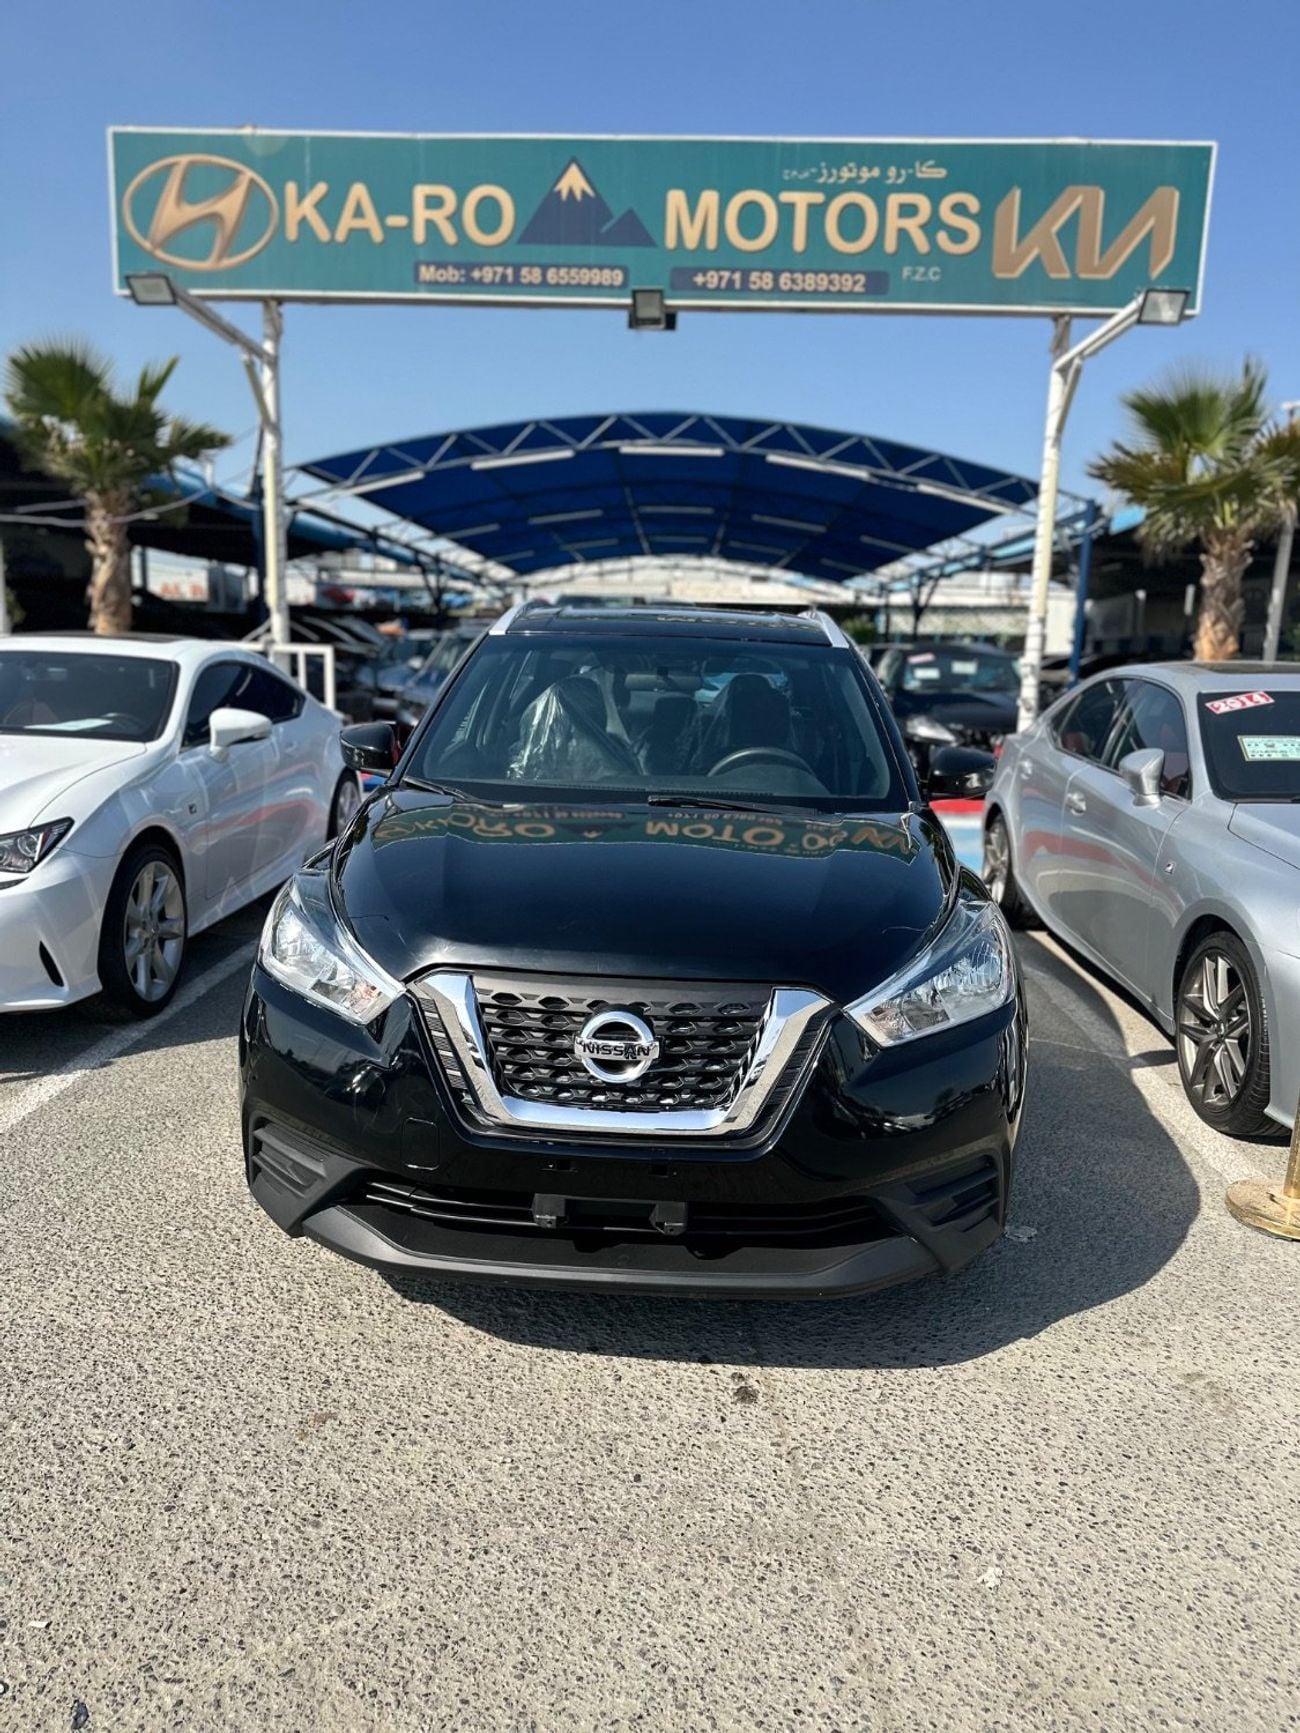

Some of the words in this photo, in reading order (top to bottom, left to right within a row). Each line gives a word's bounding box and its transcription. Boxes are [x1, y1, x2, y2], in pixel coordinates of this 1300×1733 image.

[284, 181, 516, 248] KA-RO
[664, 189, 981, 256] MOTORS
[419, 265, 465, 282] Mob:
[470, 266, 514, 283] +971
[519, 267, 542, 284] 58
[546, 267, 624, 286] 6559989
[693, 270, 741, 289] +971
[749, 272, 773, 290] 58
[778, 272, 866, 292] 6389392
[582, 1041, 650, 1060] NISSAN
